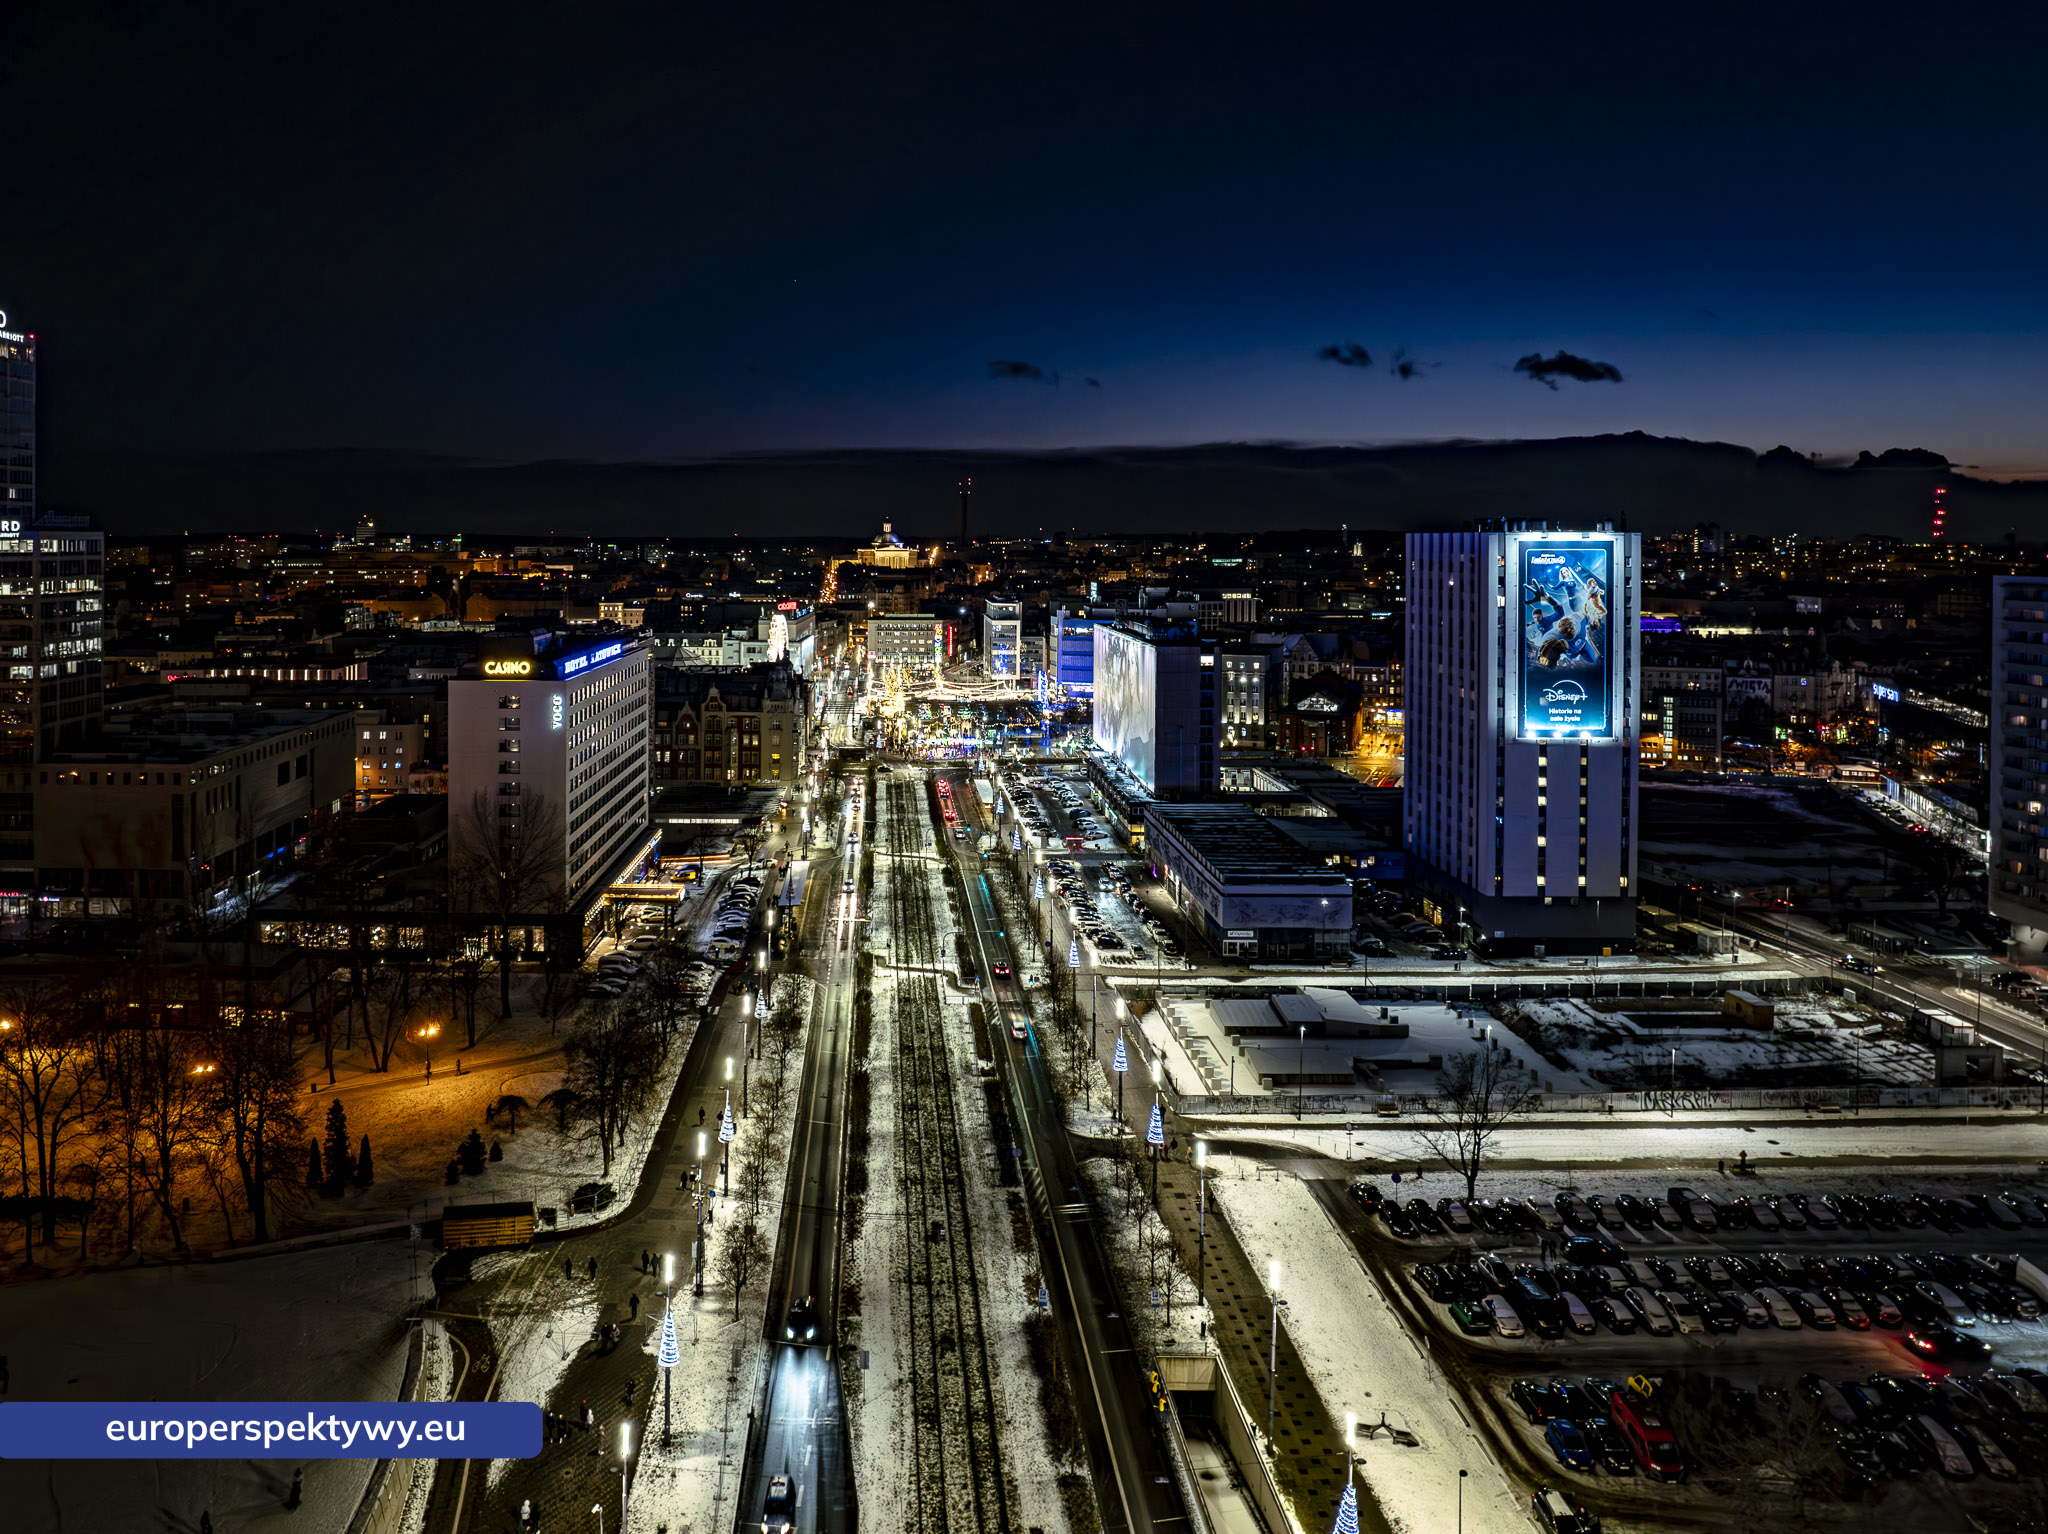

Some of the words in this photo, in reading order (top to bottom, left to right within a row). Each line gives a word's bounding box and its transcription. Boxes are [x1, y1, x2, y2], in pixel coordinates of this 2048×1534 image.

[484, 661, 531, 674] CASINO
[564, 655, 588, 674] HOTEL
[1543, 686, 1588, 705] Disney+
